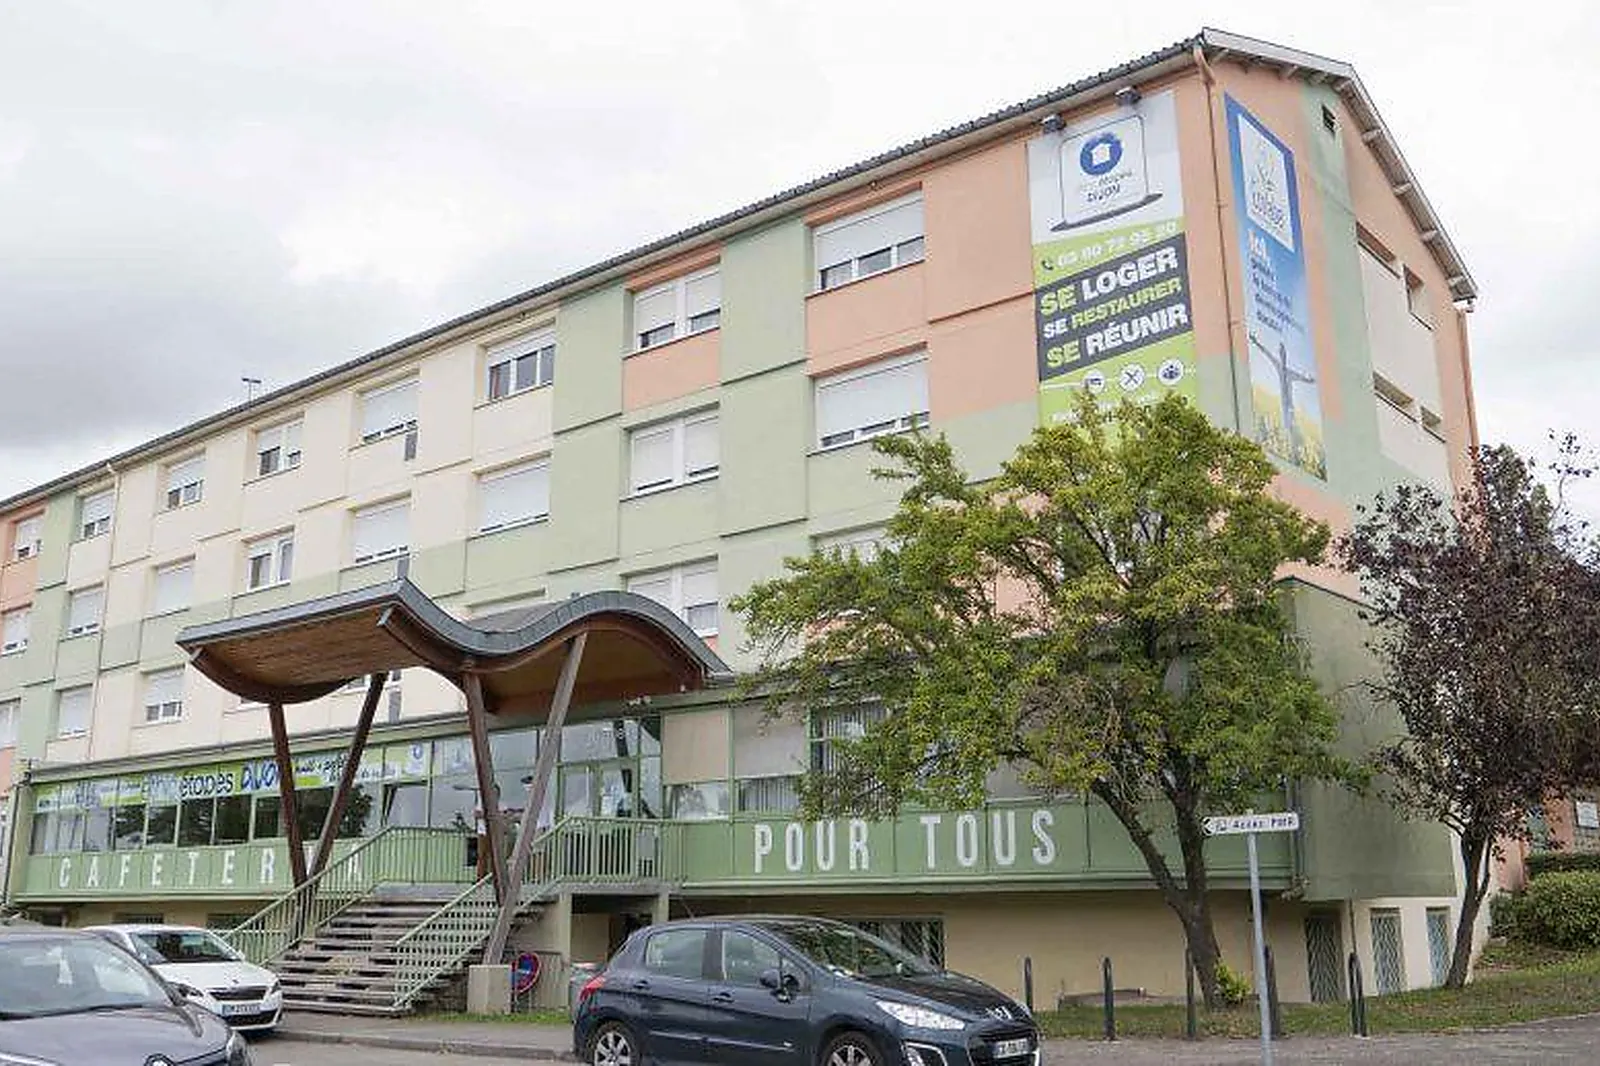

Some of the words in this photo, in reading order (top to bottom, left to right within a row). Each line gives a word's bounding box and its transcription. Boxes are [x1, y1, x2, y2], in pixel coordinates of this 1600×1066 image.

[1040, 284, 1077, 316] SE
[1081, 246, 1179, 302] LOGER
[1043, 318, 1069, 339] SE
[1071, 277, 1183, 329] RESTAURER
[1046, 340, 1082, 367] SE
[1085, 303, 1189, 357] RÉUNIR
[754, 817, 870, 874] POUR
[920, 810, 1056, 870] TOUS
